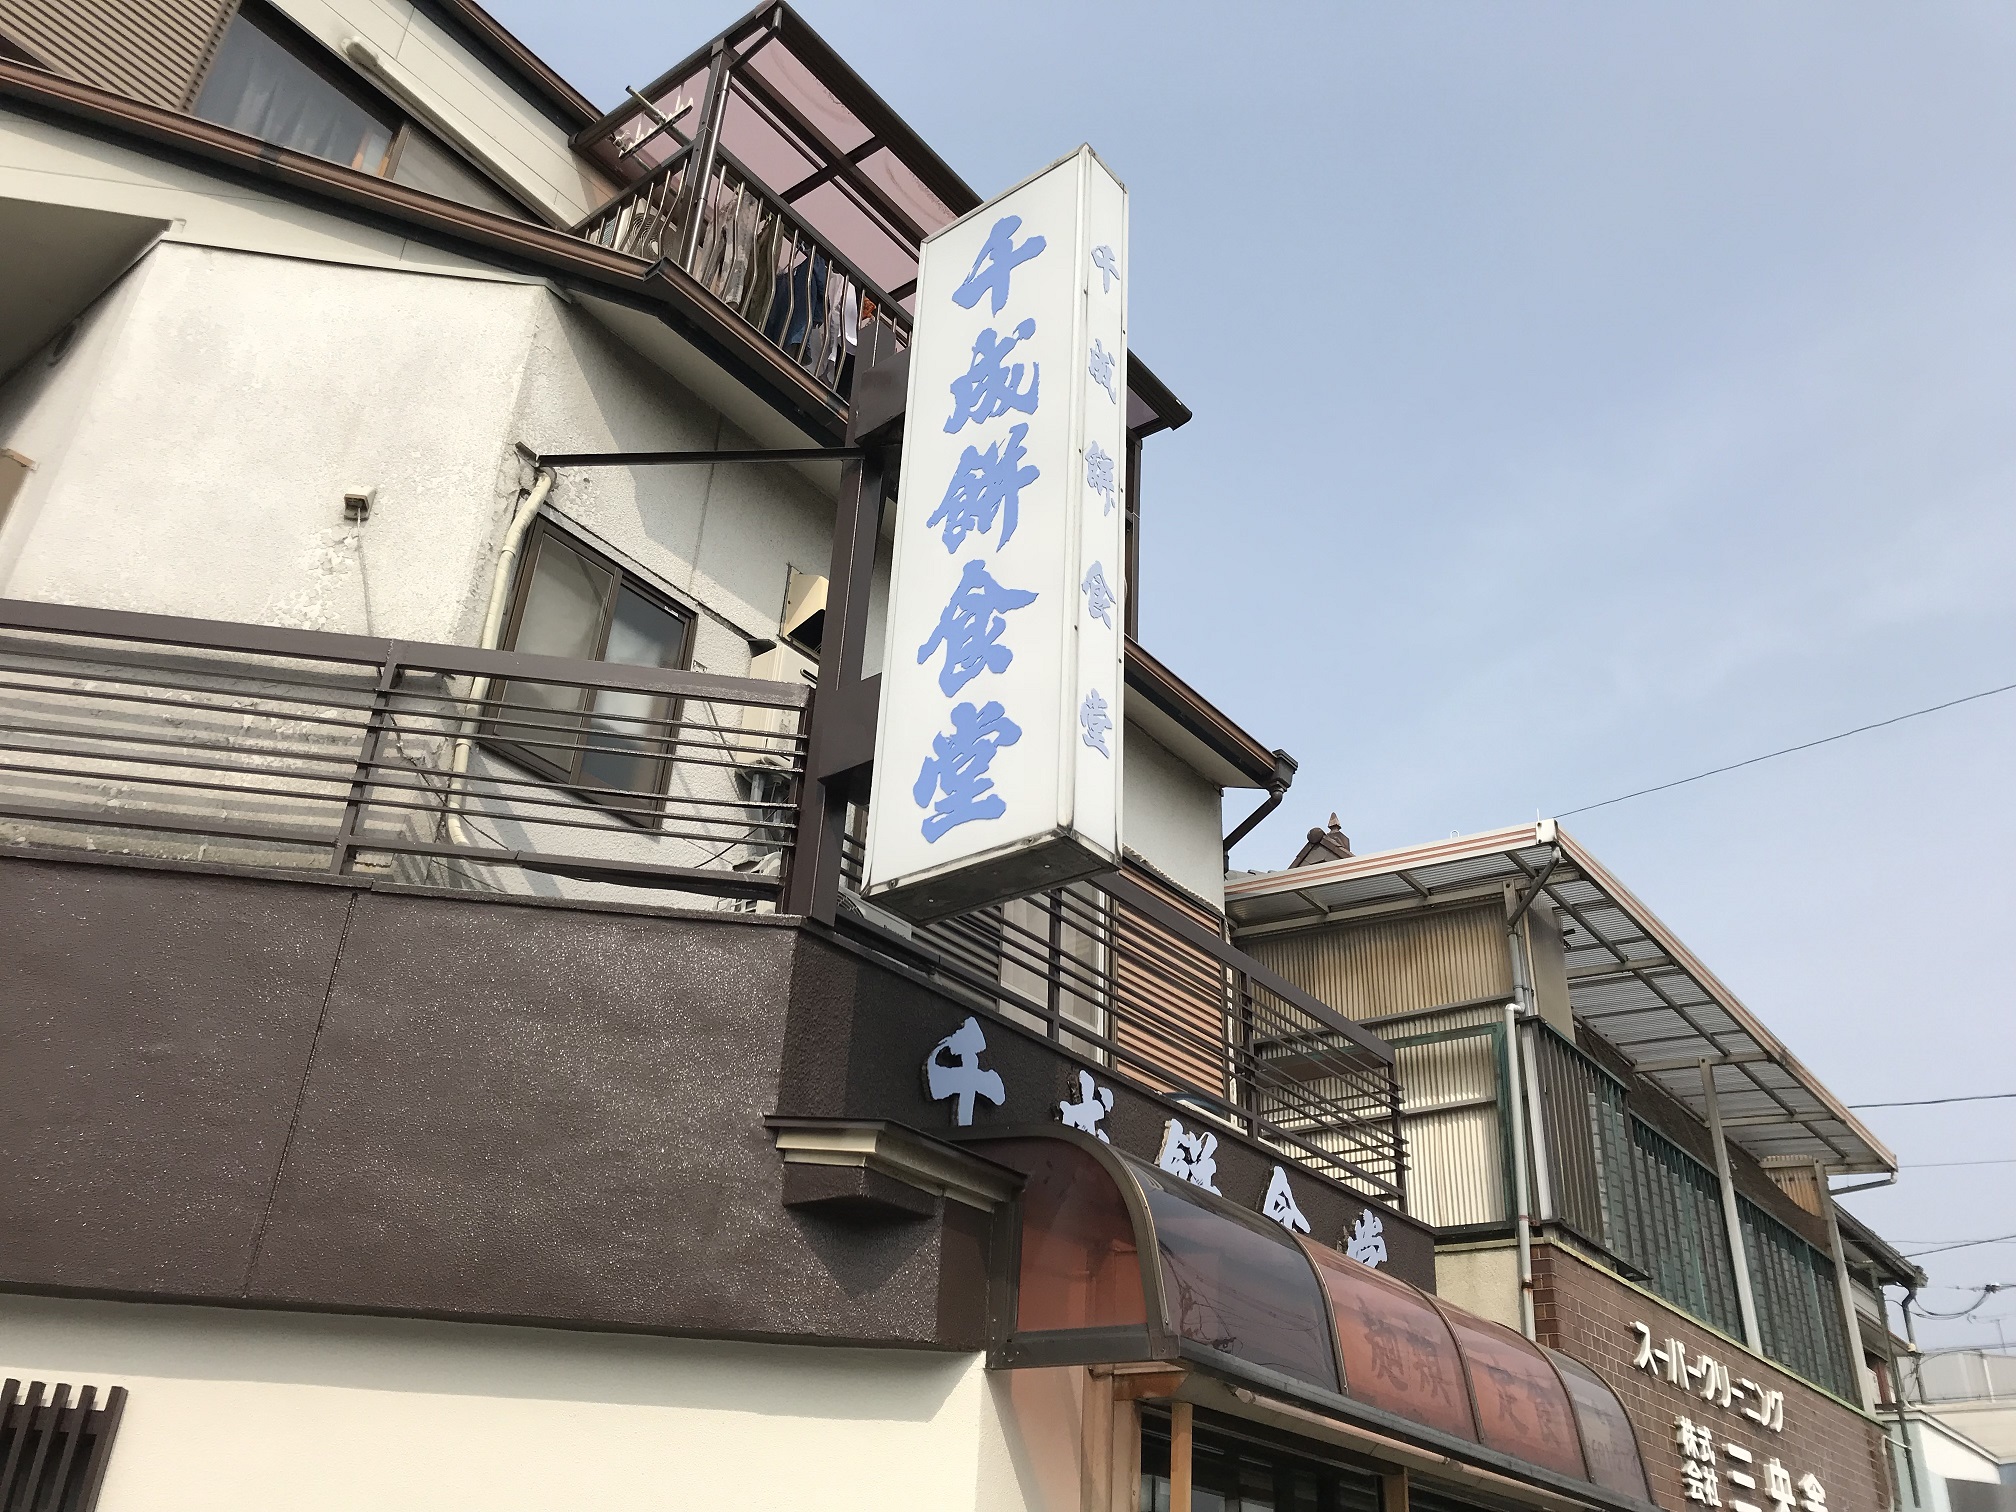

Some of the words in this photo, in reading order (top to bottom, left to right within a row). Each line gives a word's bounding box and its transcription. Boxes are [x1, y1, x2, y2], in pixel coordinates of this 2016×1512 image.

[913, 214, 1046, 844] 千成餅食堂
[1080, 244, 1120, 760] 千成餅食堂
[1630, 1321, 1784, 1432] スーパークリーニング
[1675, 1415, 1716, 1466] 株式
[1682, 1459, 1722, 1508] 会社
